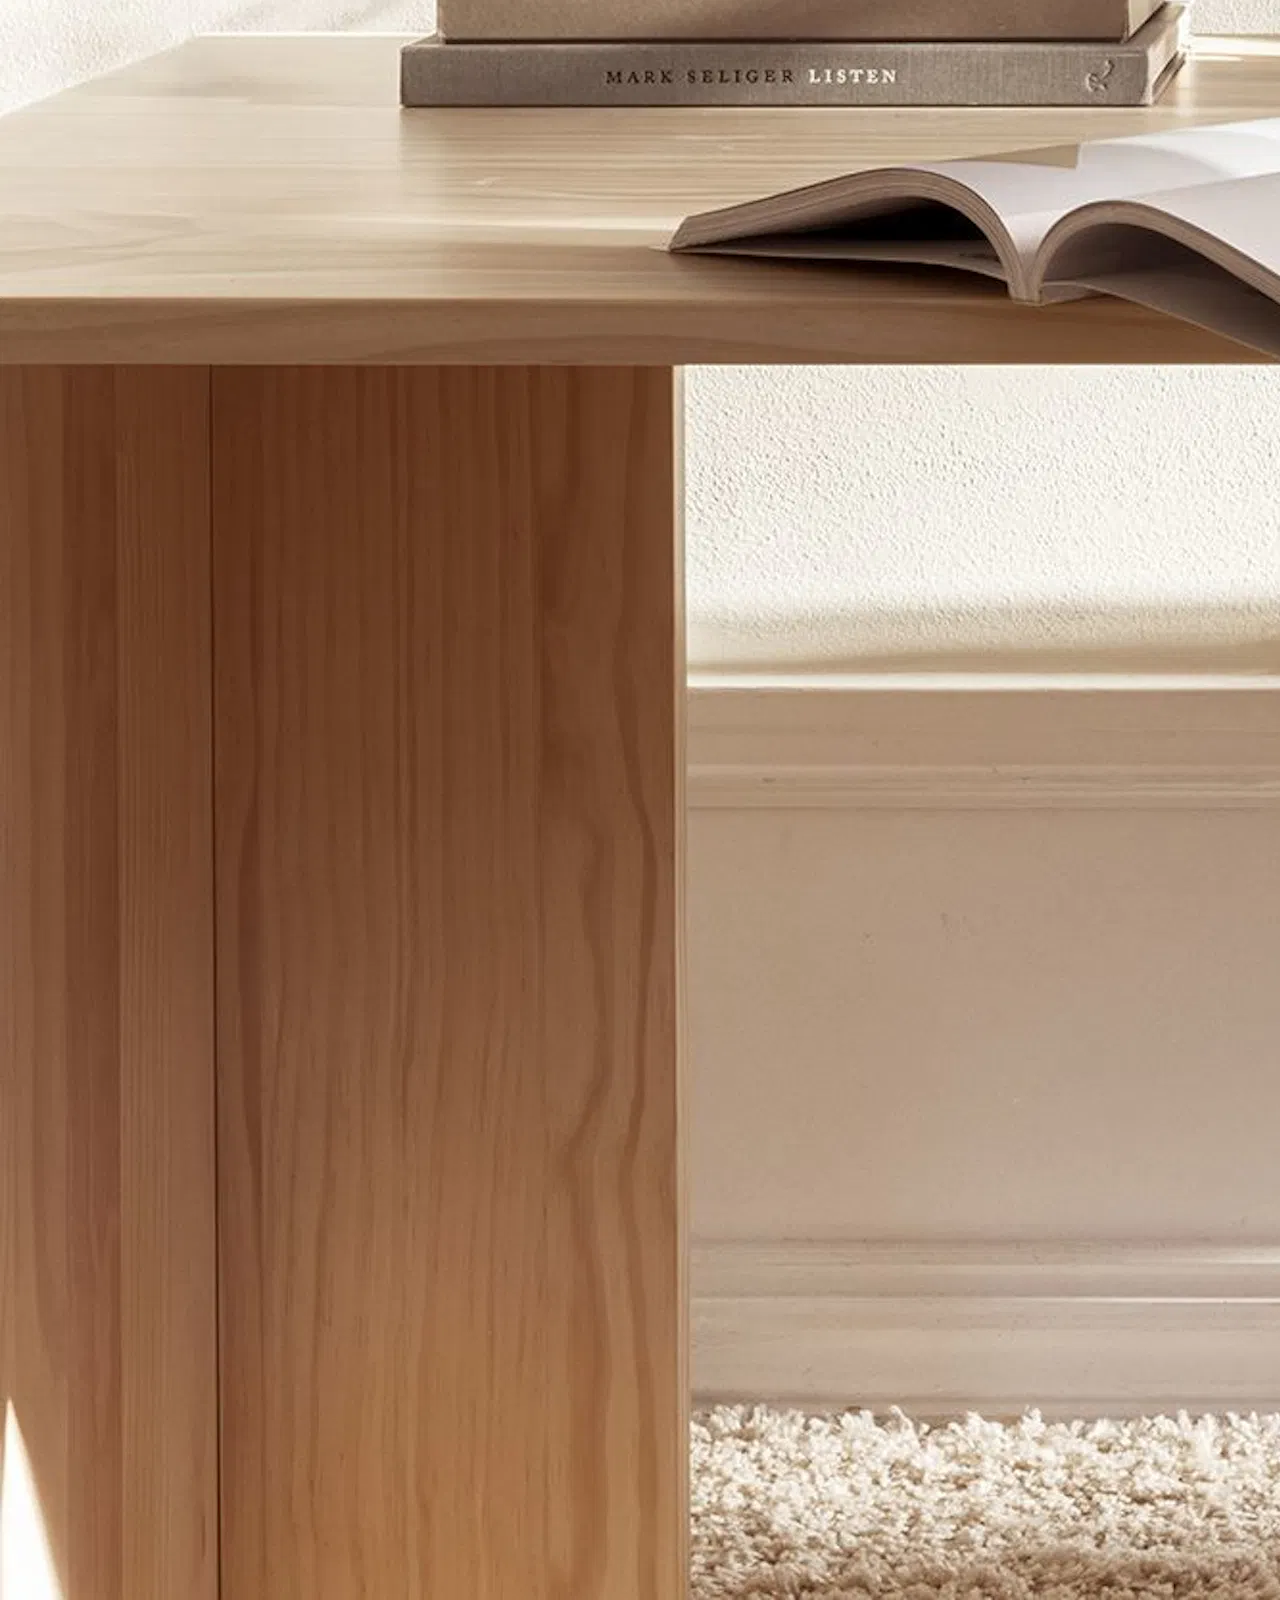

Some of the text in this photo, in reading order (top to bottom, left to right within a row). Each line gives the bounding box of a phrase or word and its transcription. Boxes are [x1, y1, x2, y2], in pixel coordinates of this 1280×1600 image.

[606, 69, 897, 84] MARK SELIGER LISTEN
